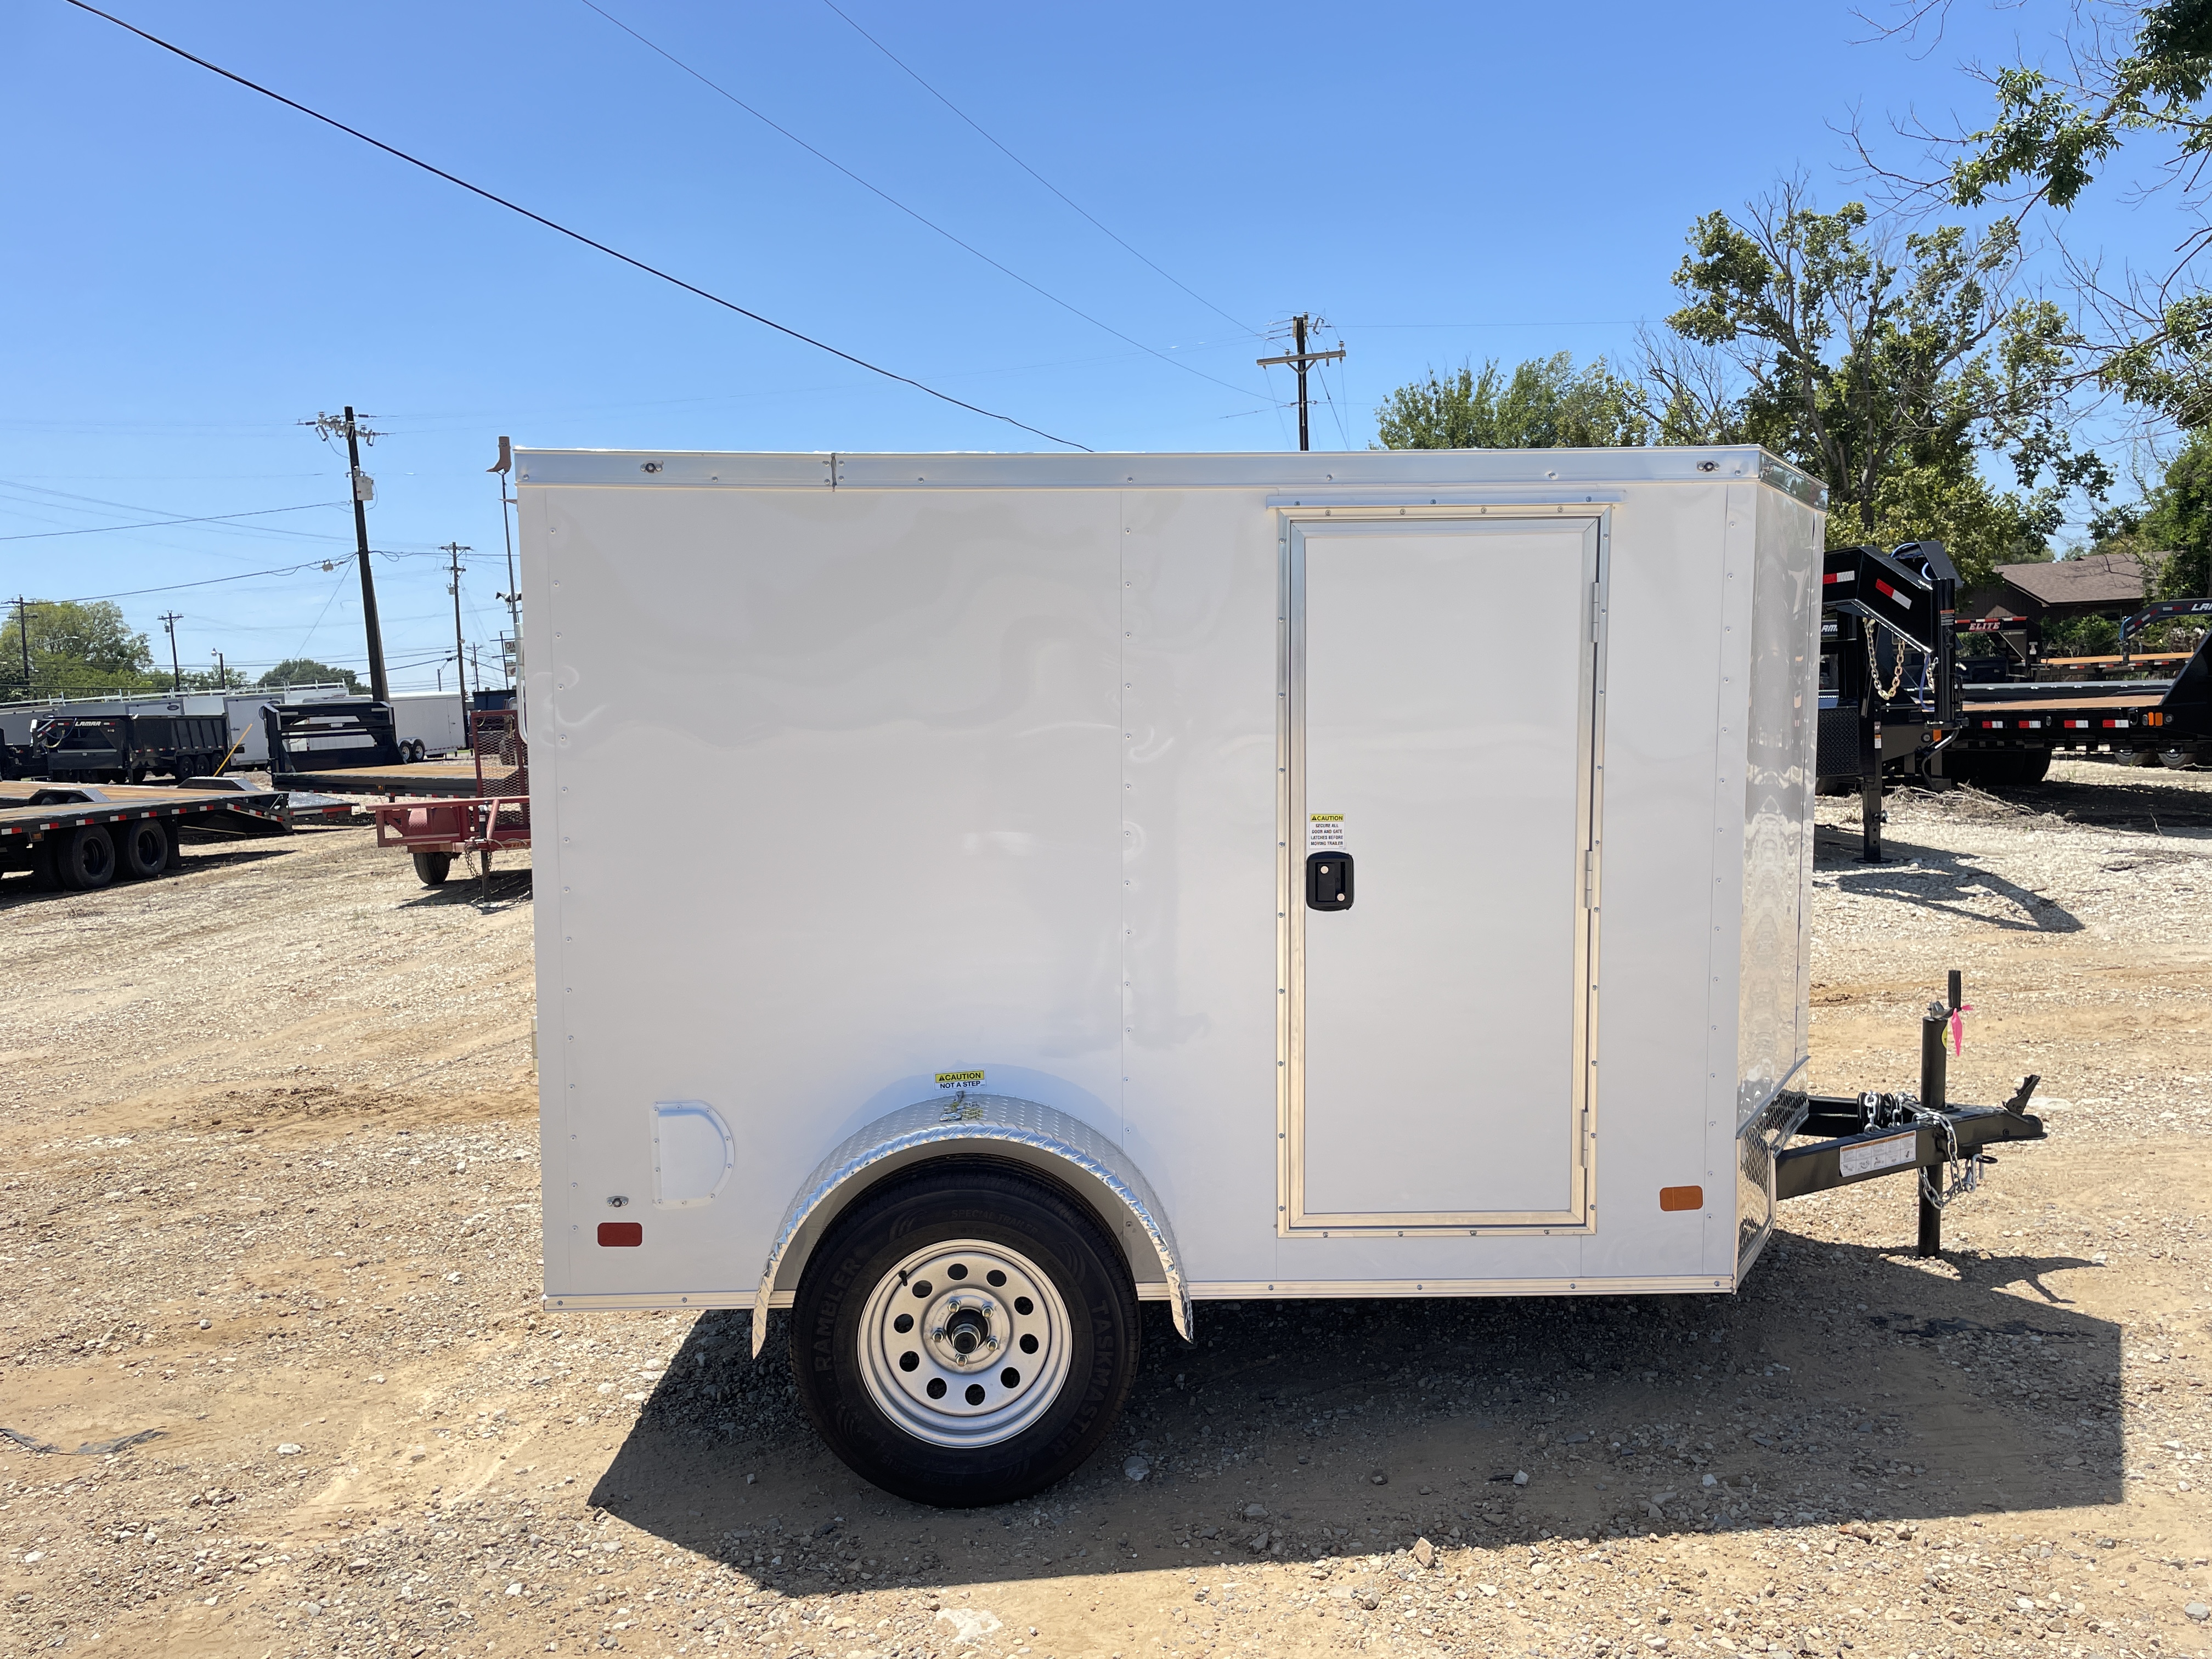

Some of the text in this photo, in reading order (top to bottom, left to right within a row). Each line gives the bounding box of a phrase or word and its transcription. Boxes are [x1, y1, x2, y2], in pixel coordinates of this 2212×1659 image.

[1968, 622, 2001, 631] ELITE
[945, 1073, 981, 1081] CAUTION
[951, 1209, 1039, 1236] SPECIAL TRAILER
[814, 1257, 862, 1372] RAMBLER
[1048, 1299, 1110, 1458] TASKMASTER
